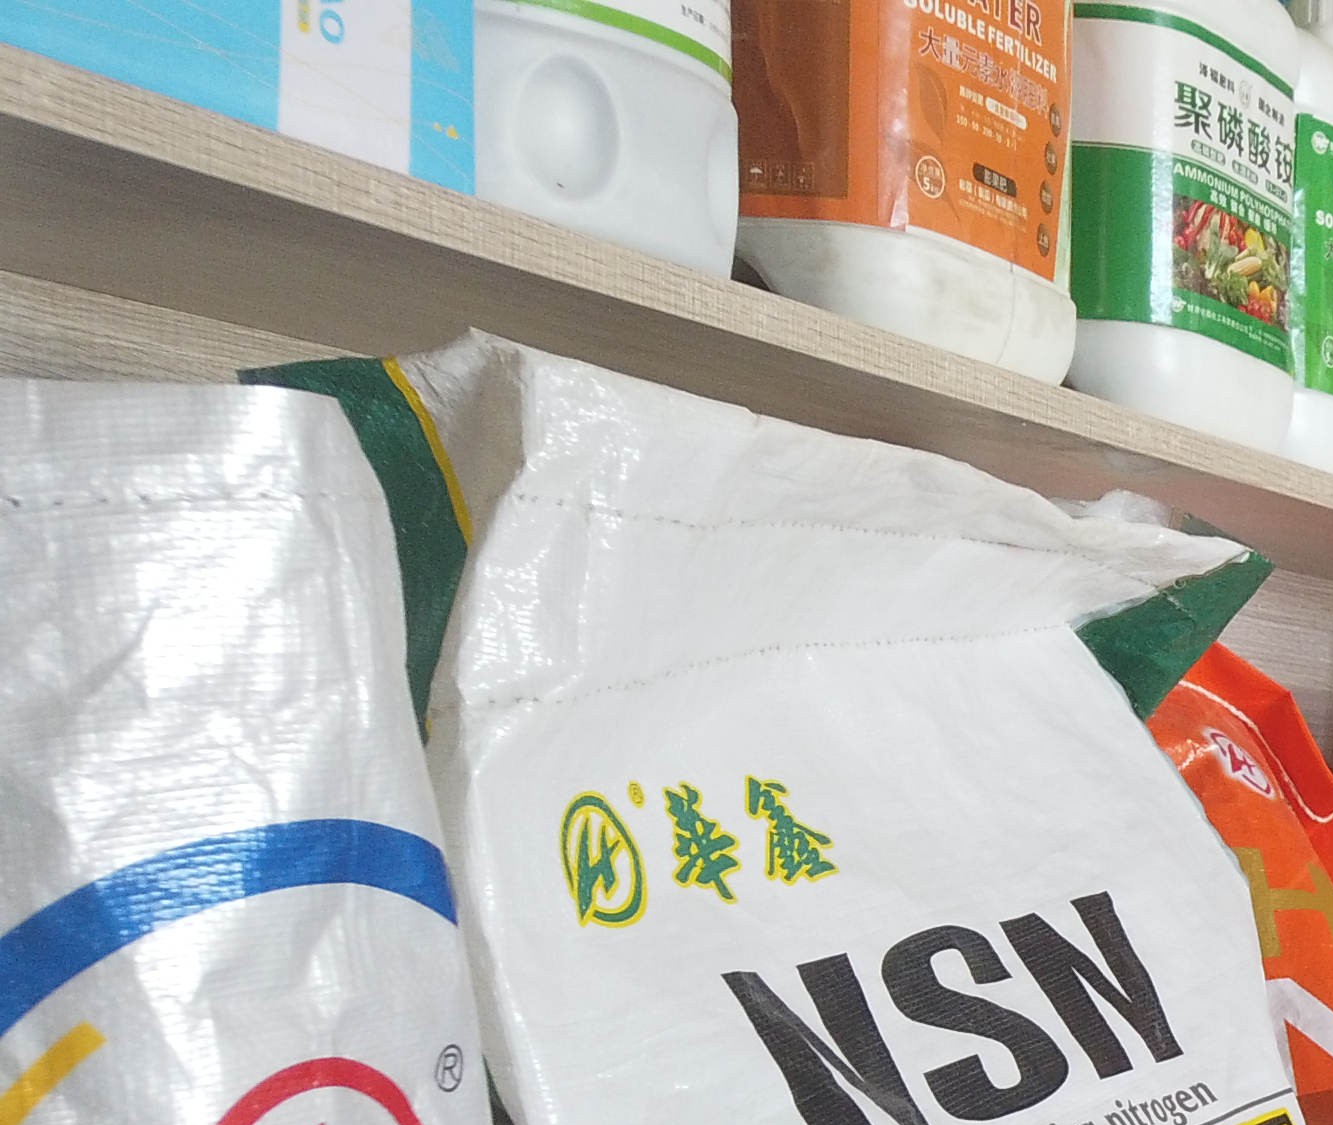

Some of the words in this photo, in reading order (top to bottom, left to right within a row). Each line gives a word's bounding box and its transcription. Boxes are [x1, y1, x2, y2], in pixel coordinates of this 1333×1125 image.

[988, 26, 1057, 83] FERTILIZER
[1174, 81, 1293, 189] 聚磷酸铵
[1173, 162, 1241, 199] AMMONIUM
